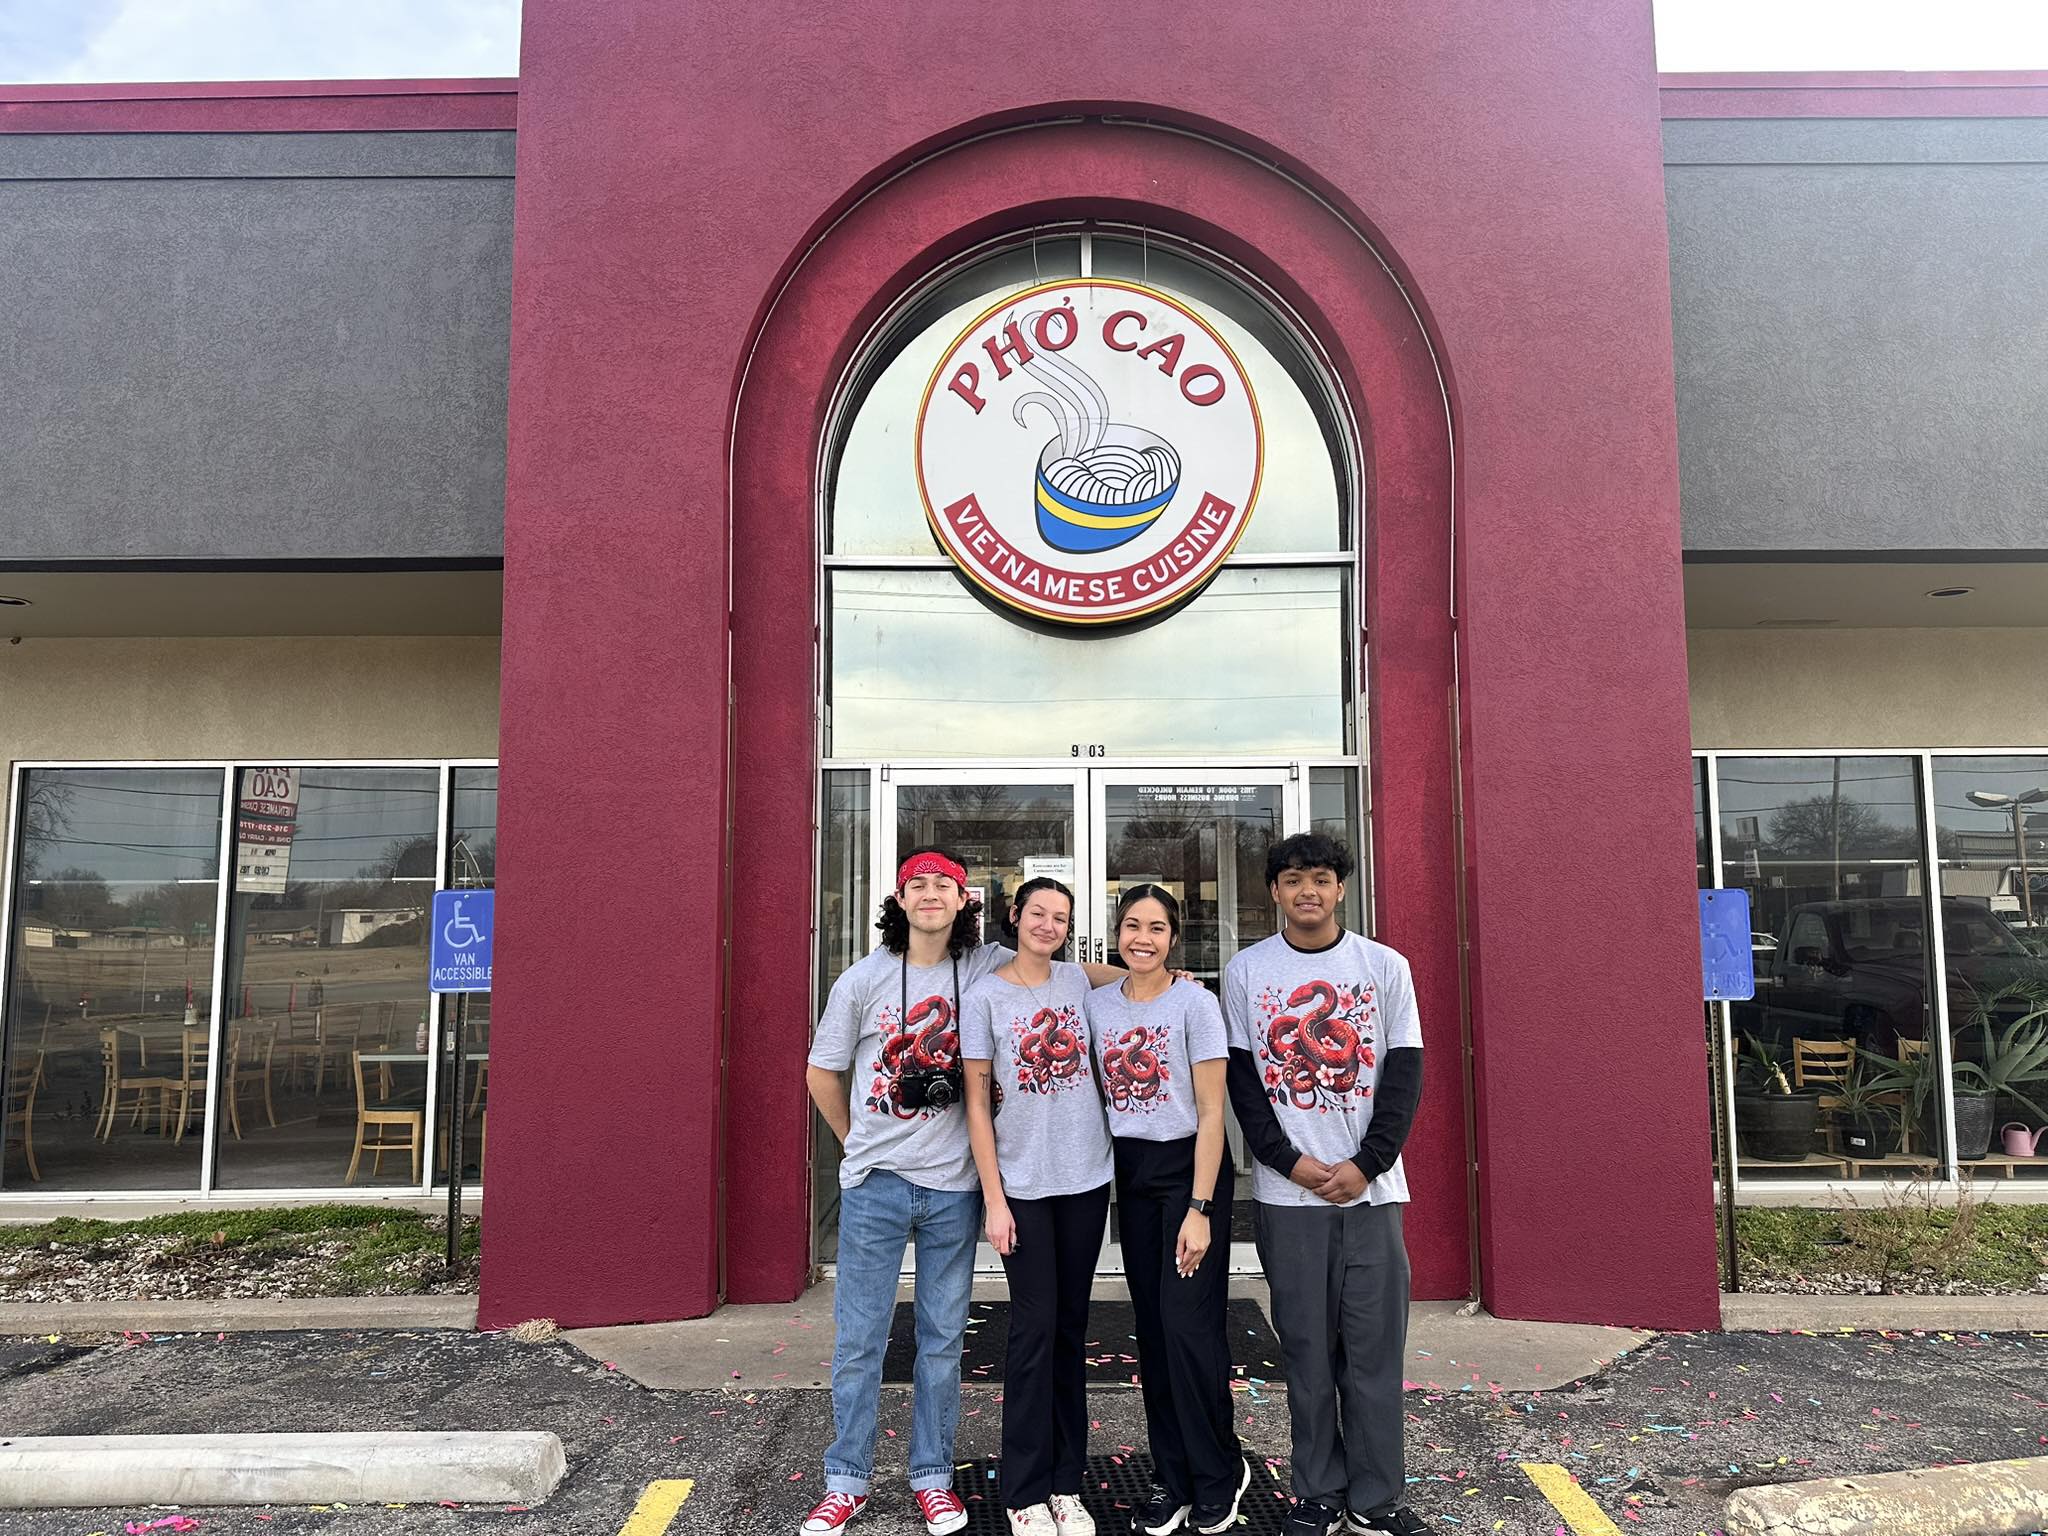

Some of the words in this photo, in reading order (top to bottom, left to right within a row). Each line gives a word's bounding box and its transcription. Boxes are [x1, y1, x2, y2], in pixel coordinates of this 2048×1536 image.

[1102, 310, 1226, 407] CAO
[956, 502, 1126, 602] VIETNAMESE
[1132, 501, 1228, 592] CUISINE
[434, 966, 493, 981] ACCESSIBLE
[454, 952, 476, 966] VAN
